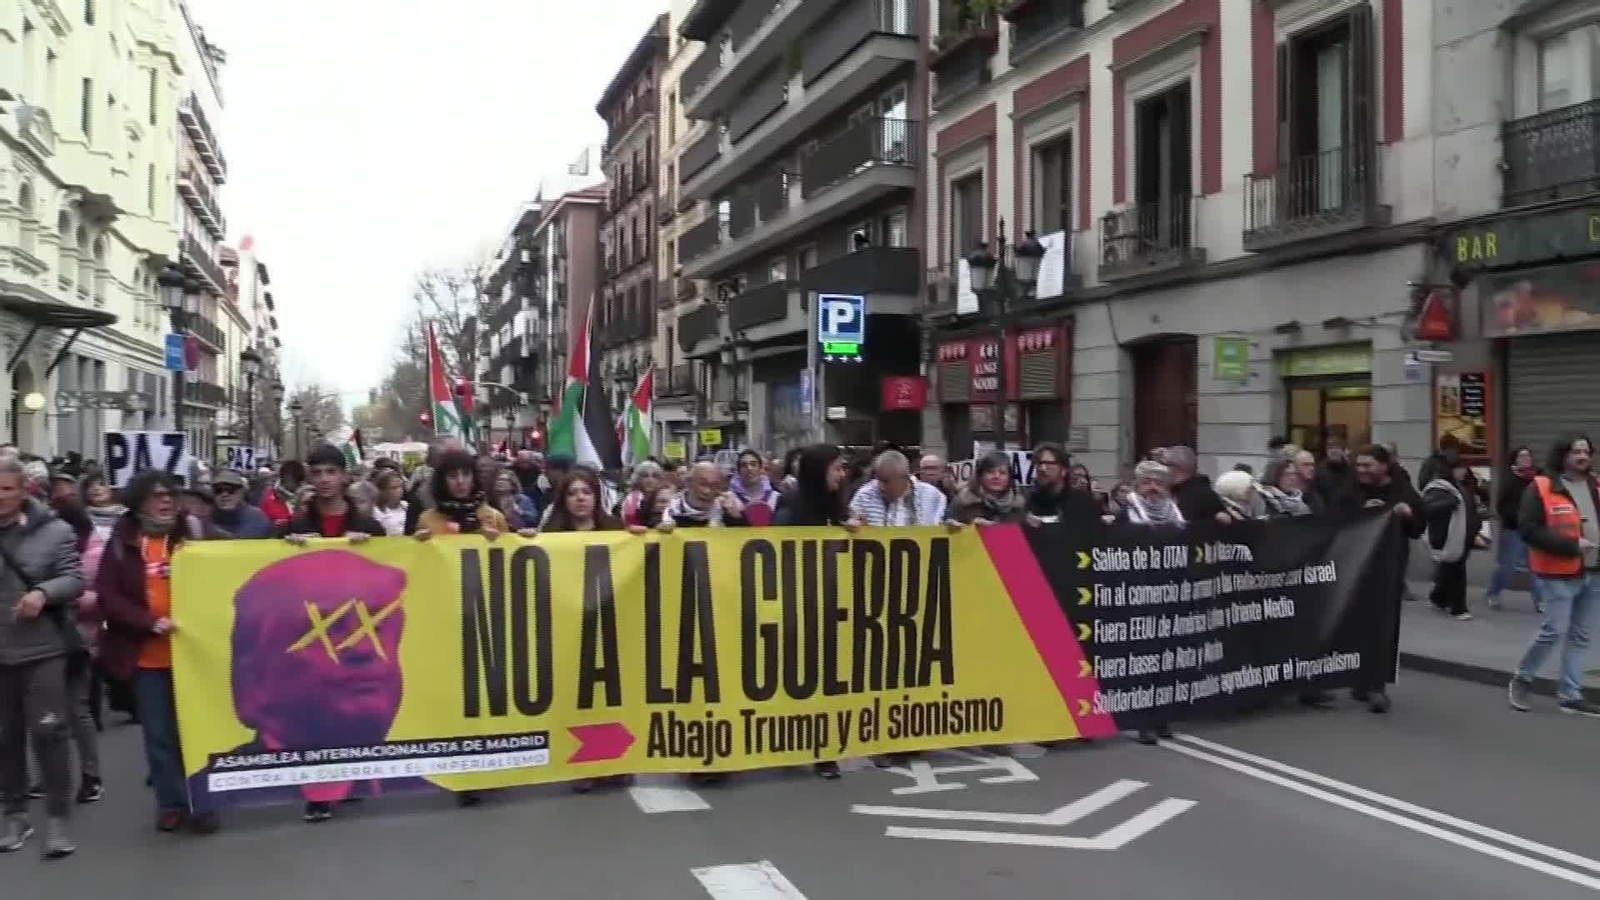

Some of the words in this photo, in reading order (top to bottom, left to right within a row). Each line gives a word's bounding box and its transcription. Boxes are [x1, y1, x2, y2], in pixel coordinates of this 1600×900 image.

[1457, 232, 1497, 261] BAR
[828, 302, 854, 334] P
[106, 432, 186, 487] PAZ
[228, 446, 253, 469] PAZ
[1012, 452, 1035, 484] AZ
[1092, 546, 1130, 571] Salida
[1132, 545, 1148, 570] de
[1150, 545, 1161, 569] la
[1163, 545, 1188, 569] OTAN
[1094, 583, 1111, 607] Fin
[1114, 582, 1126, 606] al
[1128, 580, 1178, 605] comercio
[1180, 578, 1191, 601] de
[1304, 560, 1336, 584] Israel
[460, 545, 553, 718] NO
[577, 545, 622, 709] A
[644, 540, 721, 704] LA
[740, 537, 955, 701] GUERRA
[1094, 619, 1127, 644] Fuera
[1130, 615, 1156, 640] EEUU
[1158, 613, 1171, 638] de
[1263, 596, 1295, 620] Medio
[1094, 655, 1127, 679] Fuera
[1129, 652, 1161, 675] bases
[1162, 648, 1174, 671] de
[1093, 684, 1154, 714] Solidaridad
[1175, 679, 1189, 702] los
[1263, 663, 1281, 688] por
[1283, 657, 1294, 680] el
[1295, 650, 1360, 680] imperialismo
[646, 711, 732, 766] Abajo
[740, 708, 829, 759] Trump
[837, 710, 853, 754] y
[858, 697, 881, 742] el
[888, 691, 1004, 740] sionismo
[214, 751, 302, 768] ASAMBLEA
[303, 741, 459, 761] INTERNACIONALISTA
[462, 740, 484, 752] DE
[485, 734, 545, 751] MADRID
[213, 773, 282, 788] CONTRA
[292, 769, 310, 782] LA
[317, 764, 384, 779] GUERRA
[405, 762, 423, 774] EL
[432, 754, 546, 771] IMPERIALISMO
